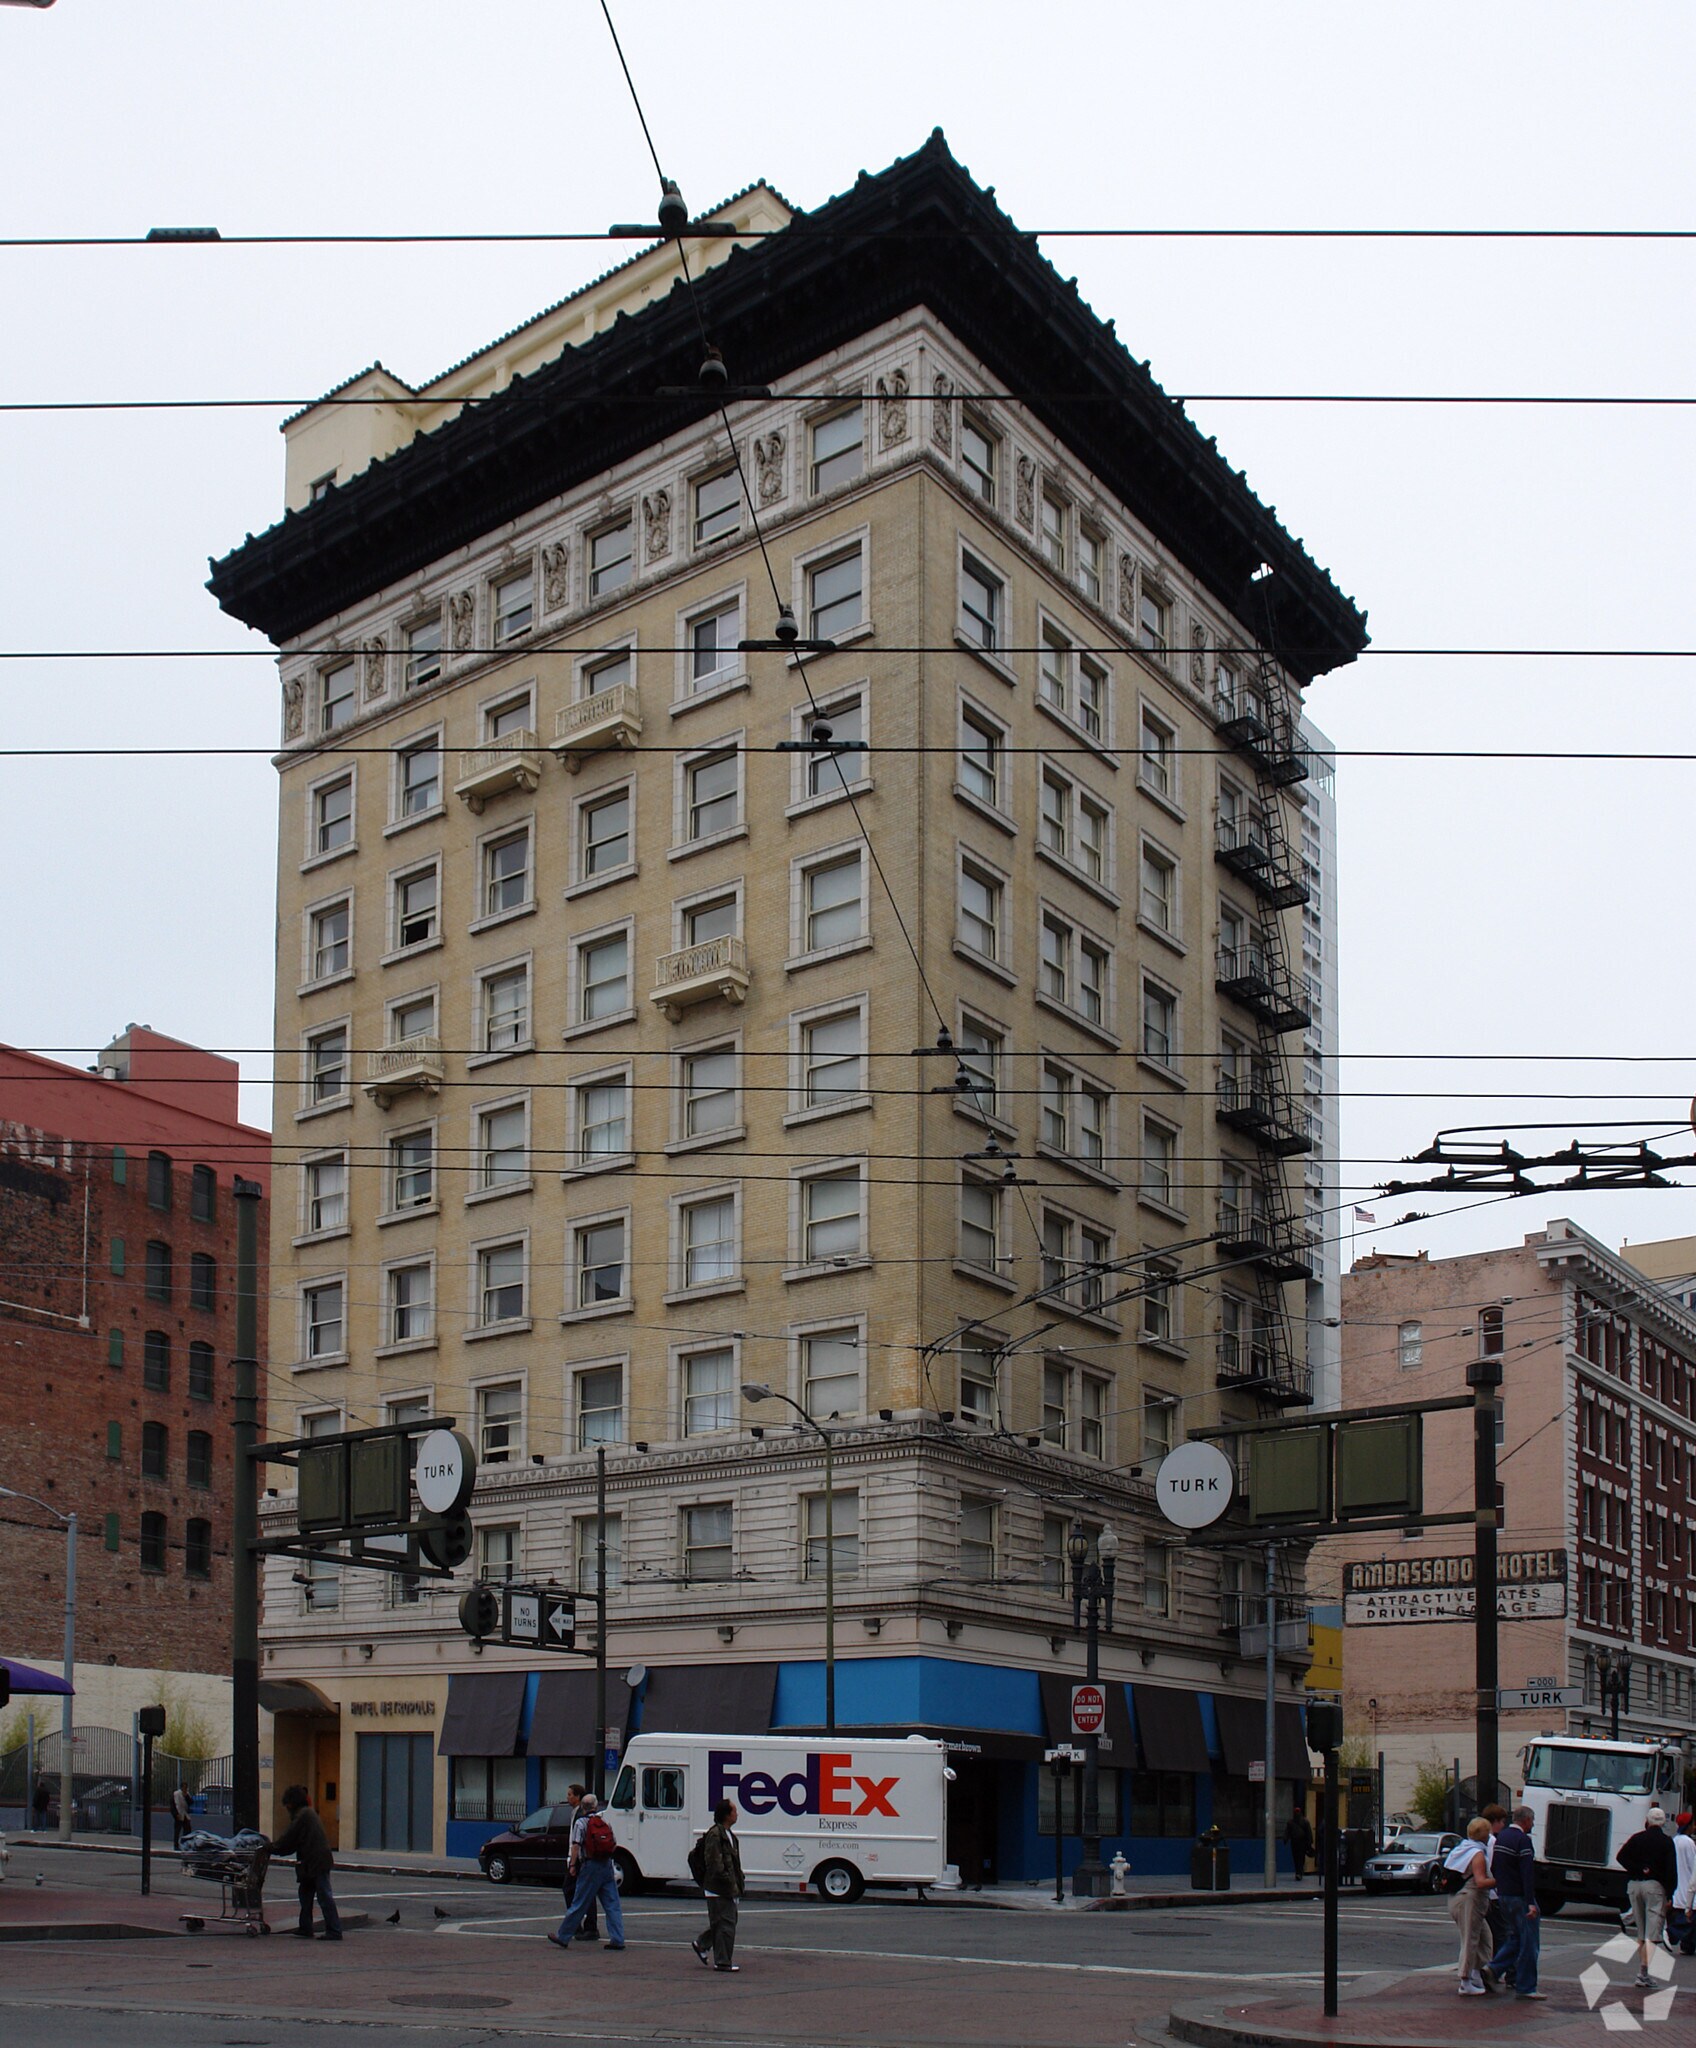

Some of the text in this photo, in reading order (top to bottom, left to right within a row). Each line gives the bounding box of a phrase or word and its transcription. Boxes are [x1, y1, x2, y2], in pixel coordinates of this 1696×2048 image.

[424, 1463, 454, 1479] TURK
[1169, 1478, 1218, 1492] TURK
[1352, 1551, 1559, 1588] AMBASSADO HOTEL
[1367, 1588, 1541, 1606] ATTRACTIVE ATES
[520, 1607, 530, 1616] NO
[1367, 1602, 1536, 1619] DRIVE-IN GAAGE
[514, 1617, 537, 1628] TURNS
[1076, 1695, 1100, 1703] DO NOT
[1520, 1692, 1562, 1704] TURK
[1077, 1715, 1098, 1724] ENTER
[708, 1751, 900, 1816] FedEx
[818, 1818, 858, 1832] Express
[818, 1840, 859, 1850] fedex.com
